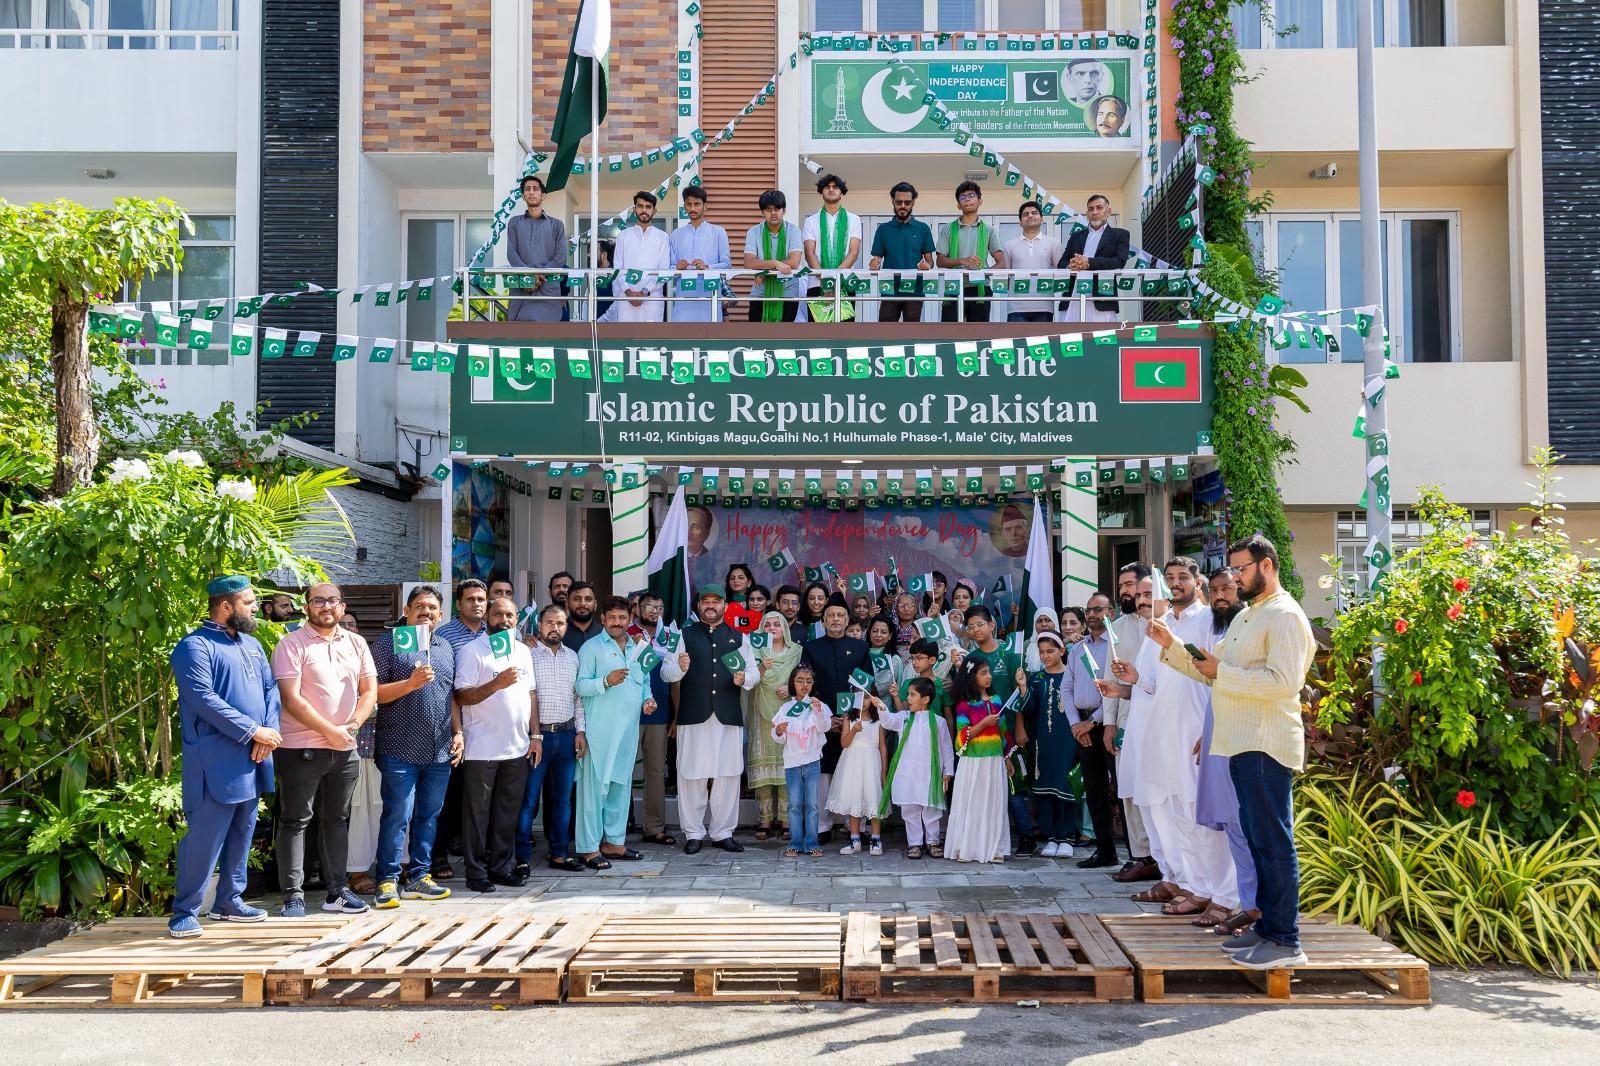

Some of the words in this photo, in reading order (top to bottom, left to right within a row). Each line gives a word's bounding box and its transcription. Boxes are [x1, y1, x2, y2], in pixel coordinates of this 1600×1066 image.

[952, 64, 984, 73] HAPPY
[929, 77, 1006, 87] INDEPENDENCE
[957, 91, 978, 100] DAY
[960, 108, 980, 117] tribute
[983, 108, 989, 117] to
[990, 108, 1000, 117] the
[1001, 106, 1023, 117] Father
[1025, 106, 1032, 117] of
[1034, 106, 1045, 116] the
[1046, 106, 1069, 116] Nation
[974, 119, 1004, 130] leaders
[1005, 121, 1012, 130] of
[1013, 121, 1023, 130] the
[1024, 120, 1052, 130] Freedom
[1053, 120, 1085, 130] Movement
[585, 392, 716, 423] Islamic
[726, 393, 887, 432] Republic
[898, 393, 936, 424] of
[943, 393, 1099, 424] Pakistan
[619, 431, 663, 444] R11-02,
[667, 431, 720, 445] Kinbigas
[803, 431, 829, 443] No.1
[833, 431, 897, 443] Hulhumale
[900, 431, 952, 444] Phase-1,
[956, 431, 987, 443] Male'
[990, 431, 1016, 445] City,
[1020, 431, 1073, 443] Maldives
[726, 511, 788, 556] Happy
[797, 511, 931, 552] Independence
[938, 511, 980, 557] Day
